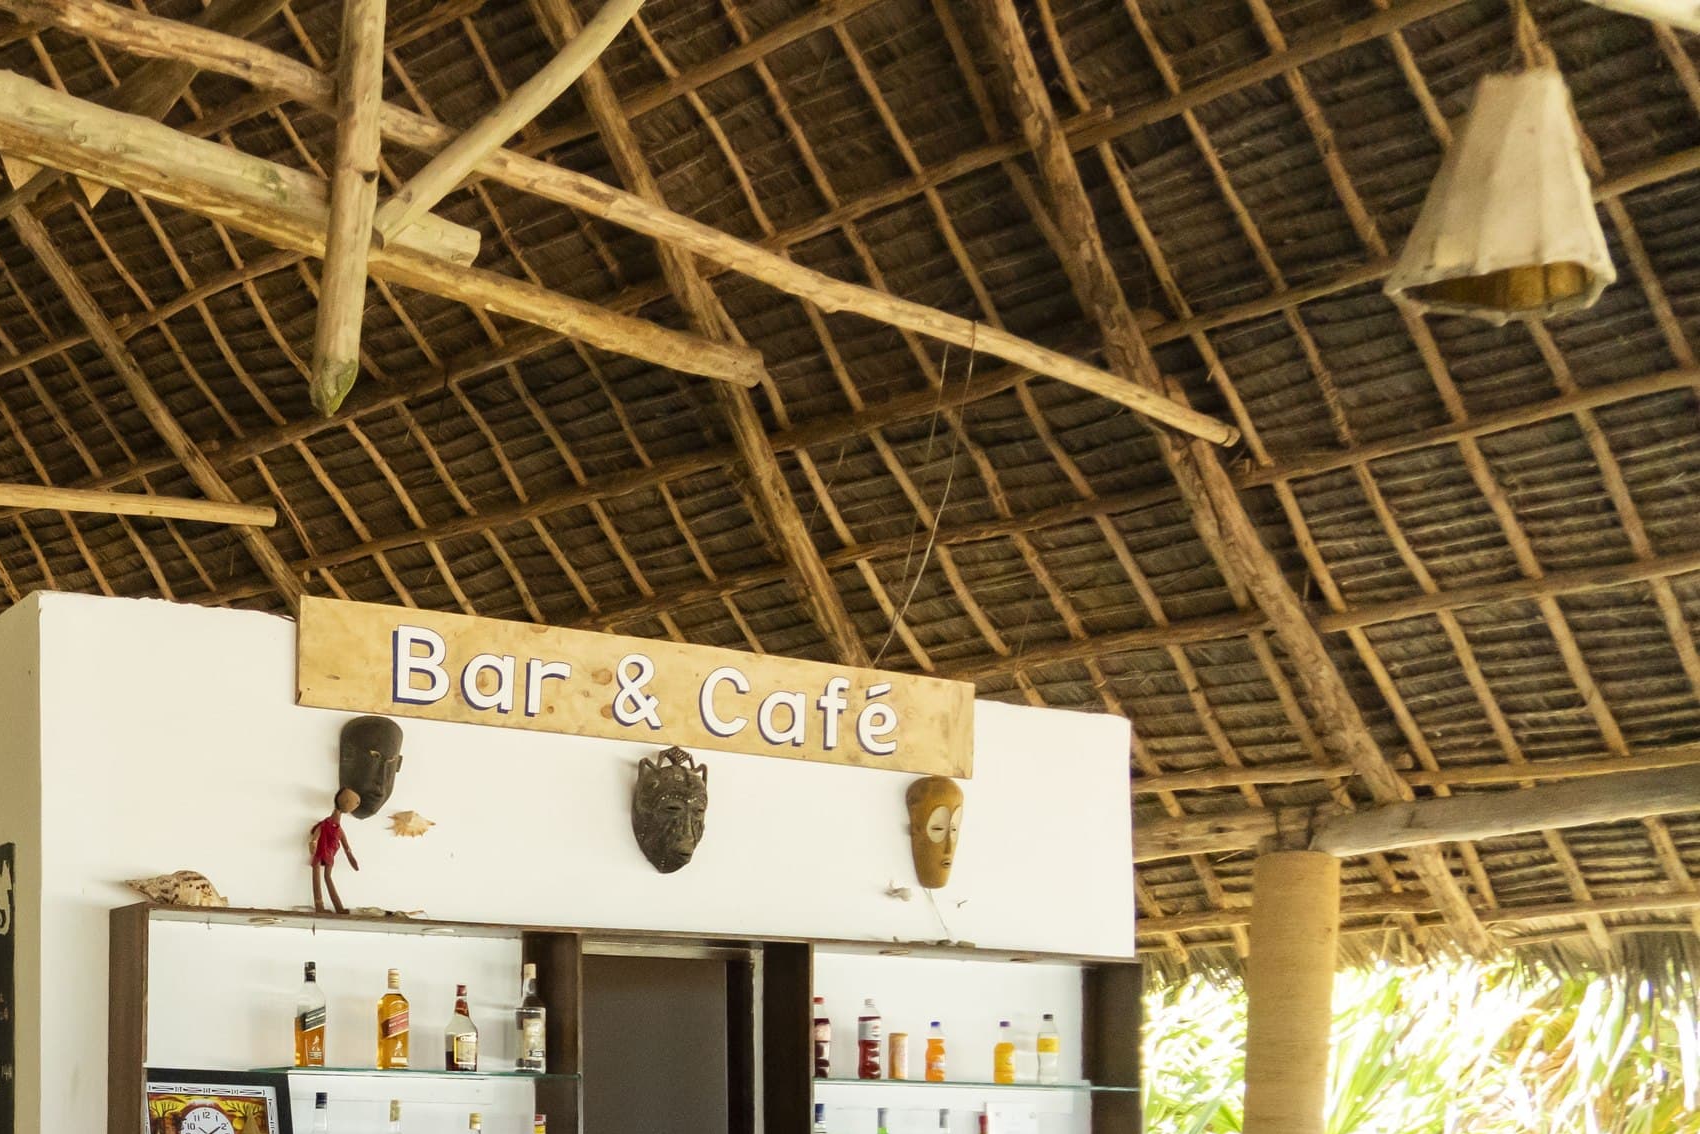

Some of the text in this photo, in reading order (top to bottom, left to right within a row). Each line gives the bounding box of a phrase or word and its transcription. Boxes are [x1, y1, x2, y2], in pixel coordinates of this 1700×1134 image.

[393, 625, 899, 756] Bar & Café
